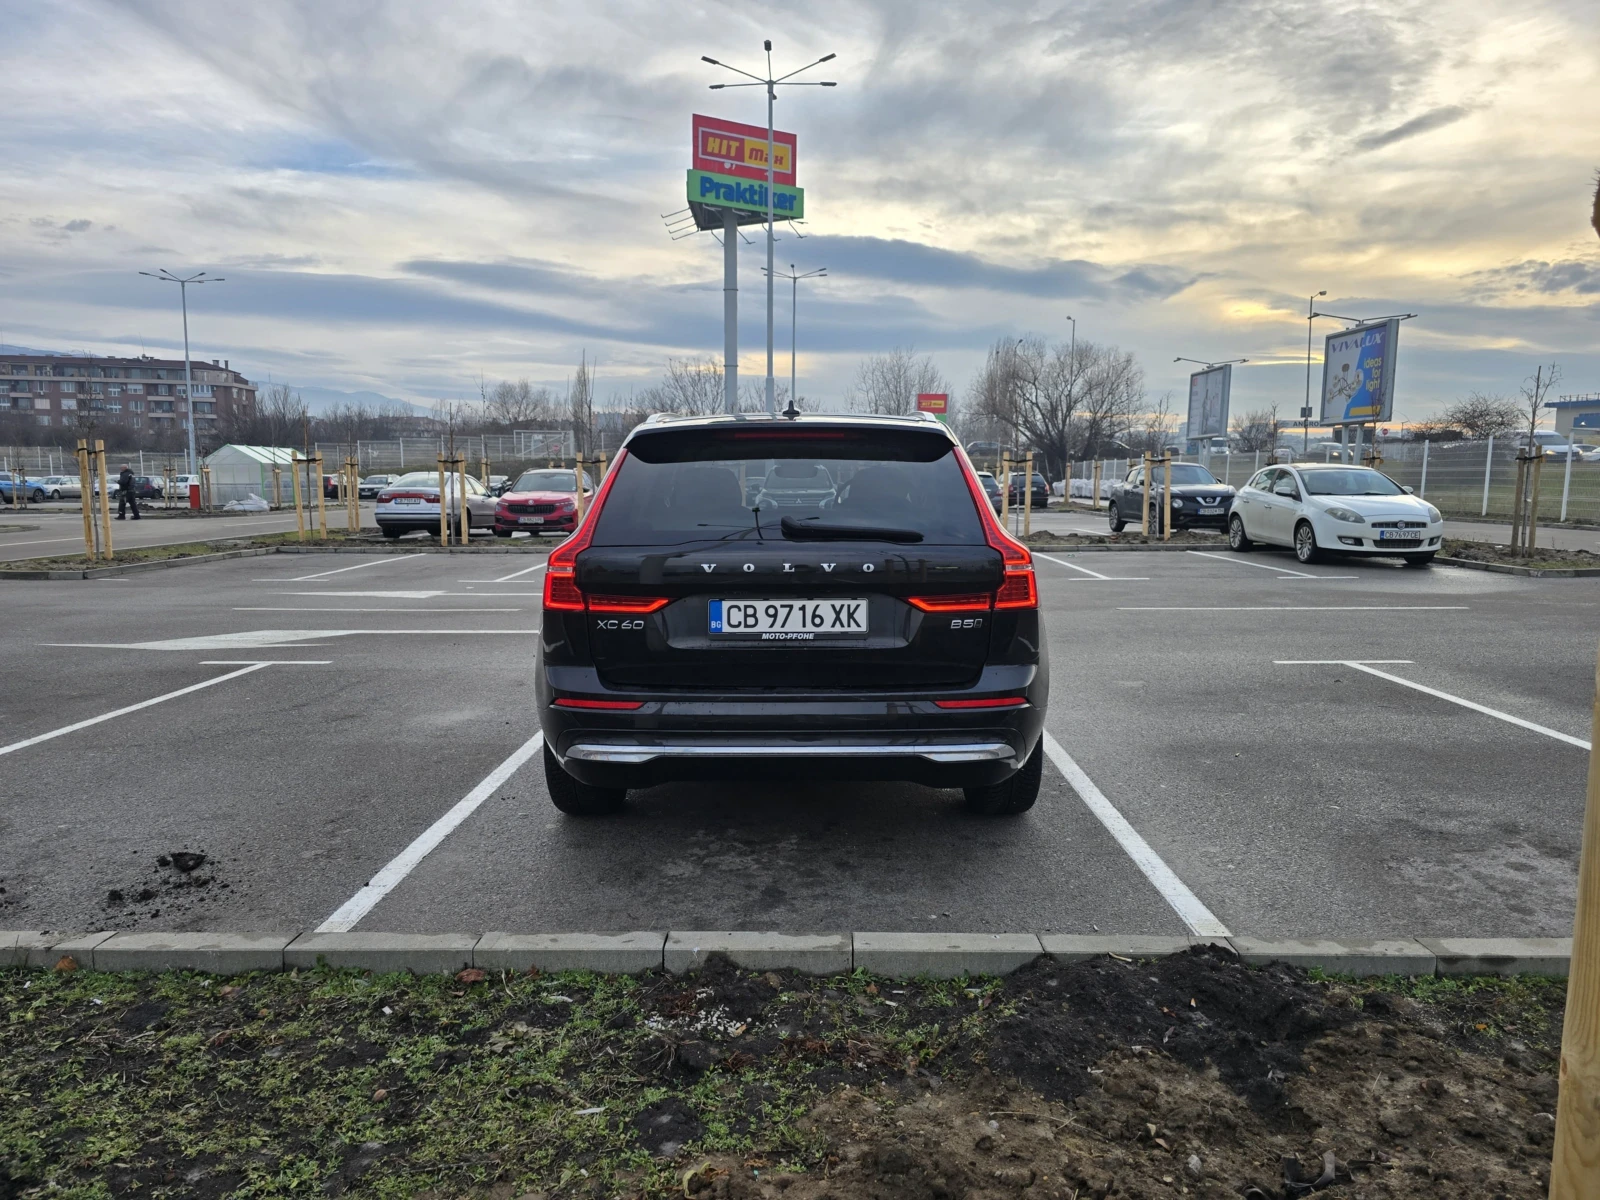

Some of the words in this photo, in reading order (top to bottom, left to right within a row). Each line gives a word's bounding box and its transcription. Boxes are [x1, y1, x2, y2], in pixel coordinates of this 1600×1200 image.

[706, 136, 740, 157] HIT
[700, 175, 797, 211] Praktiker
[1331, 331, 1386, 353] VIVALUX
[701, 563, 875, 573] VOLVO
[711, 620, 722, 629] BG
[726, 604, 759, 629] CB
[764, 604, 825, 629] 9716
[830, 603, 862, 628] XK
[761, 632, 815, 640] MOTO-PFOHE
